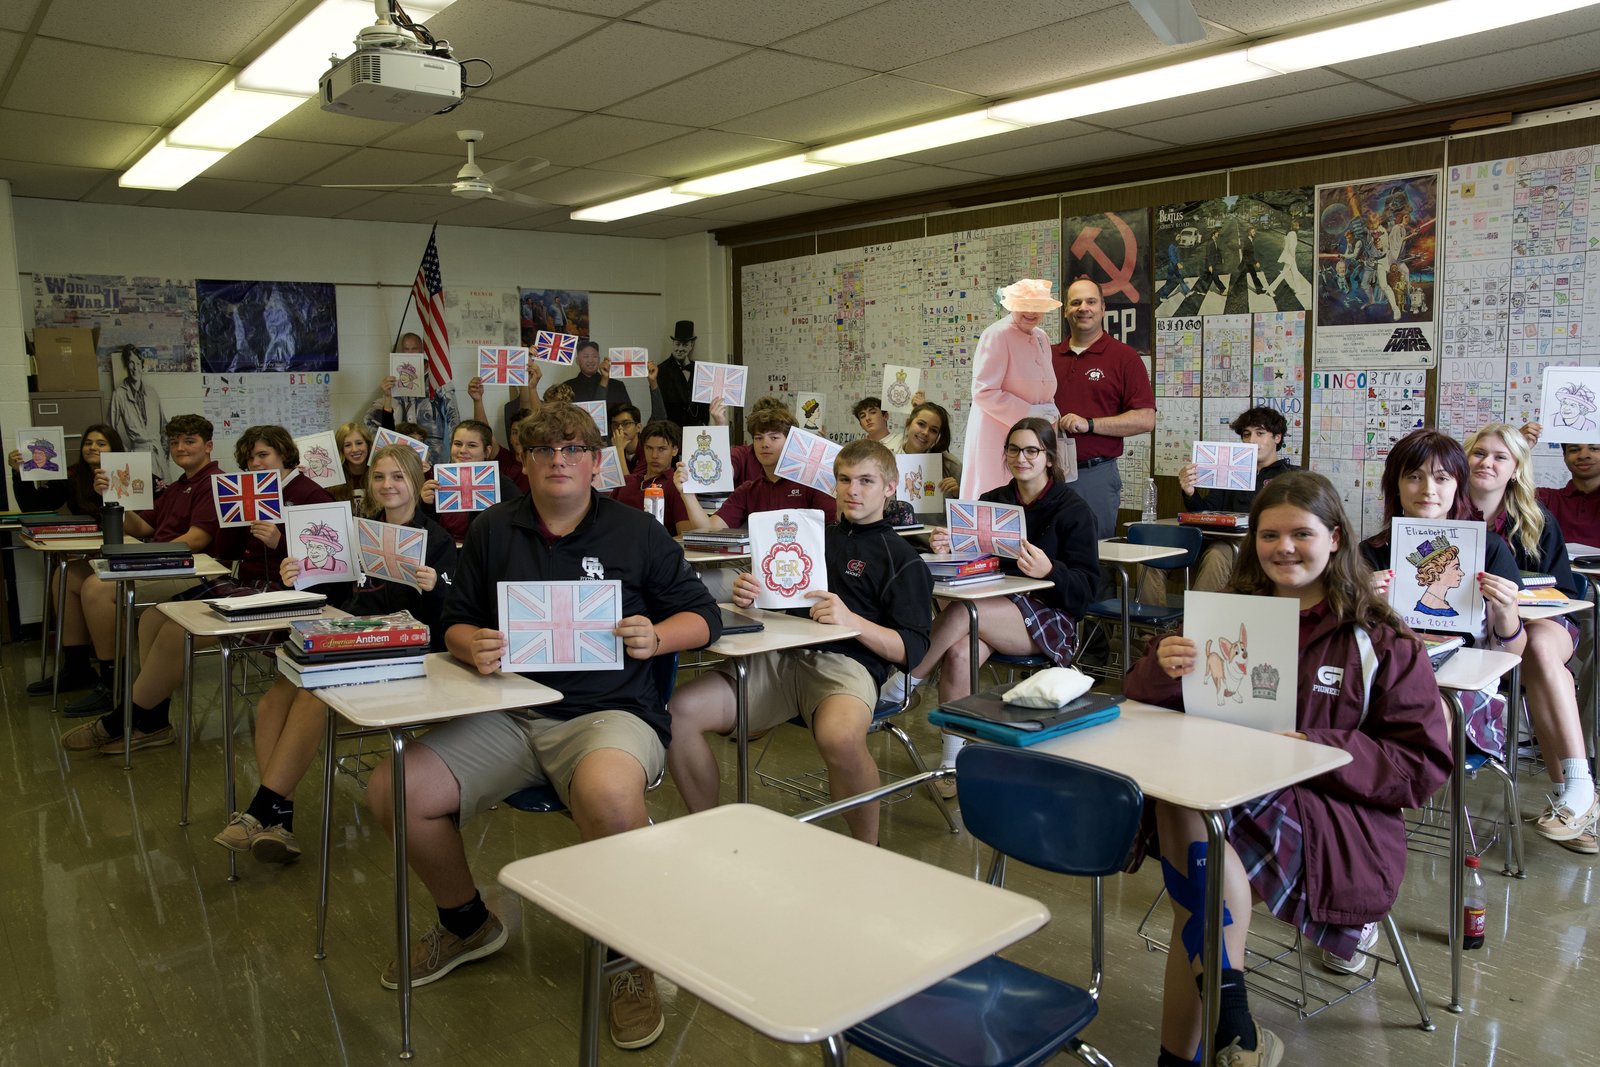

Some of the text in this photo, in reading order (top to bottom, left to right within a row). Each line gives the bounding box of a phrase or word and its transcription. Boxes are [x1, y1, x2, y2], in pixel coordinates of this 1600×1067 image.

[1451, 160, 1515, 182] BINGO
[1159, 209, 1184, 223] BEATLES
[864, 245, 892, 254] BINGO
[1513, 254, 1585, 276] BINGO
[43, 276, 100, 294] WORLD
[68, 294, 101, 309] WAR
[923, 305, 954, 315] BINGO
[1157, 319, 1201, 331] BINGO
[1391, 327, 1423, 339] STAR
[1383, 338, 1432, 352] WARS
[1451, 361, 1494, 380] BINGO
[289, 373, 330, 385] BINGO
[1313, 372, 1367, 390] BINGO
[1369, 371, 1425, 386] BINGO
[1256, 396, 1302, 414] BINGO
[1405, 526, 1460, 539] Elizabeth II
[1404, 615, 1456, 628] 926 2022
[355, 635, 389, 644] Anthem
[1196, 858, 1207, 867] KT
